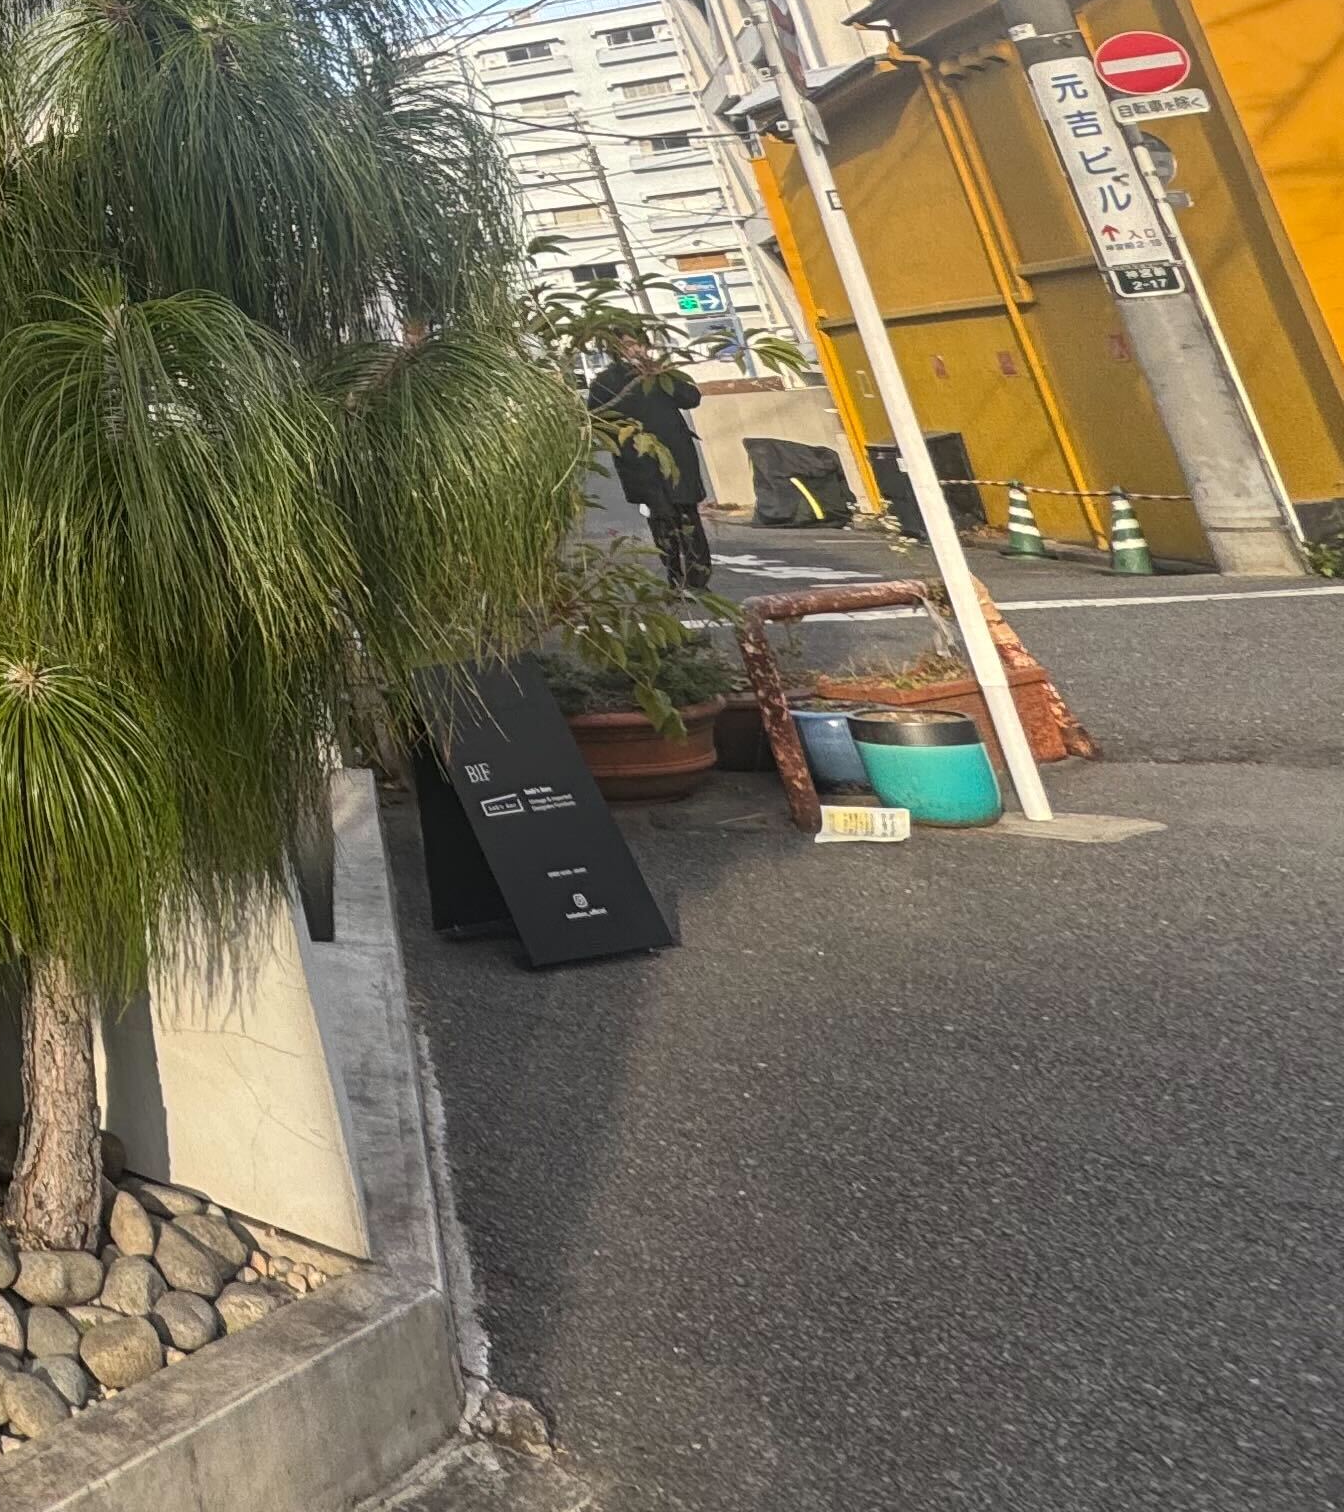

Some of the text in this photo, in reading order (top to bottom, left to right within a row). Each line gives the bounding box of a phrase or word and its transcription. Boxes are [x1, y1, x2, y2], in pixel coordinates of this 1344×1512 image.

[1118, 96, 1203, 118] 自転車を除く
[1050, 73, 1132, 213] 元吉ビル
[1128, 228, 1156, 240] 入口
[465, 762, 491, 784] B1F
